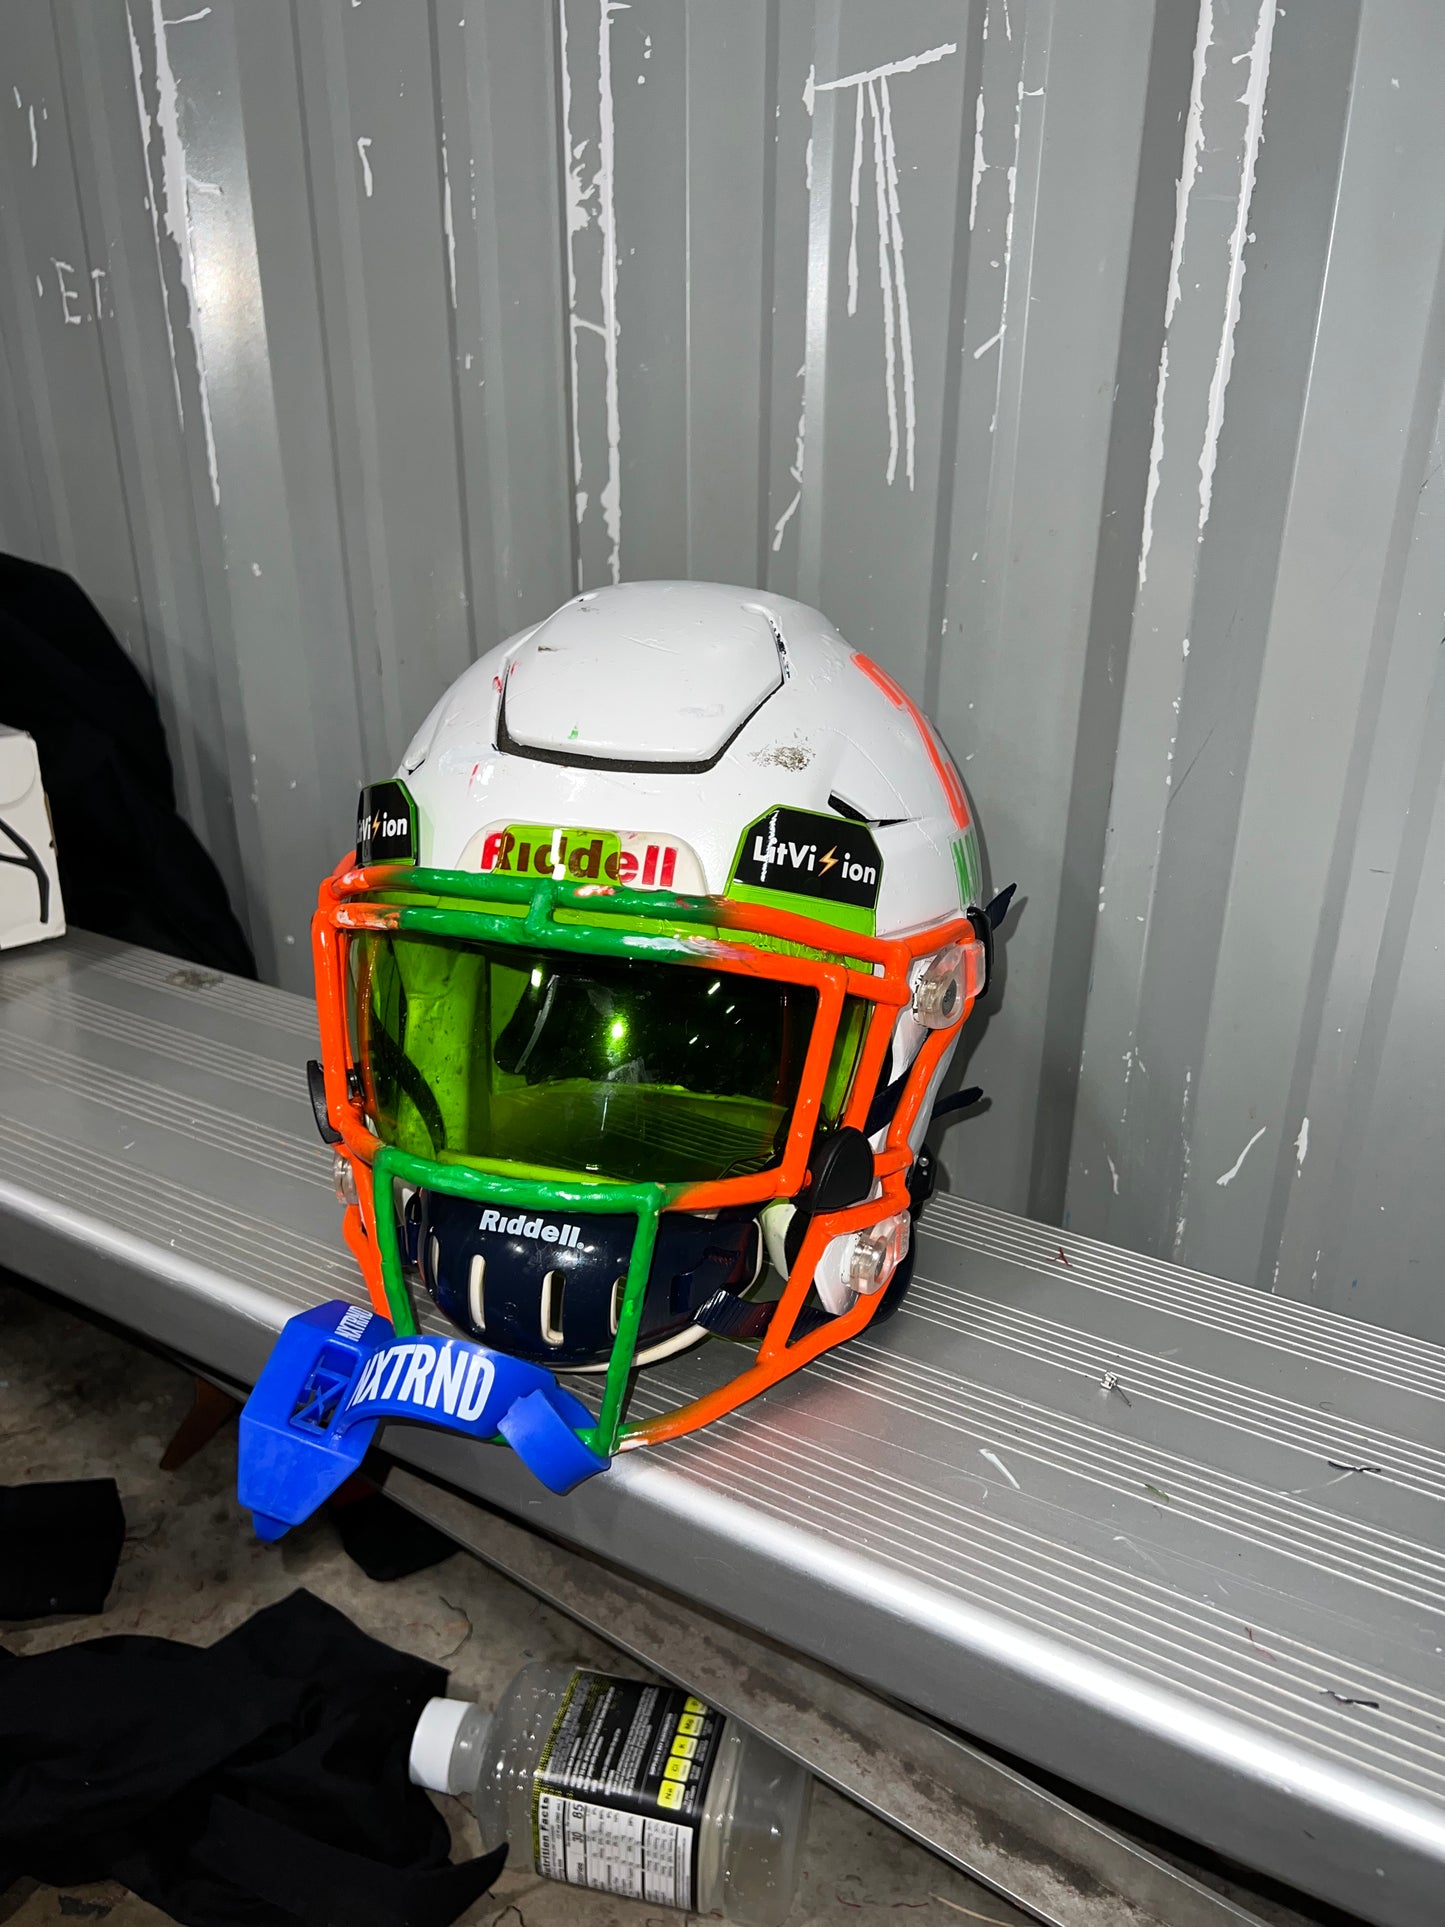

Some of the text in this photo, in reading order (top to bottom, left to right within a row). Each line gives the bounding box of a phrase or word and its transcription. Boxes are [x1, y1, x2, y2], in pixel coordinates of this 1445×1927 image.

[481, 832, 678, 887] Riddell
[334, 1305, 374, 1342] NXTRND
[345, 1343, 496, 1422] NXTRND
[572, 1804, 585, 1819] 85
